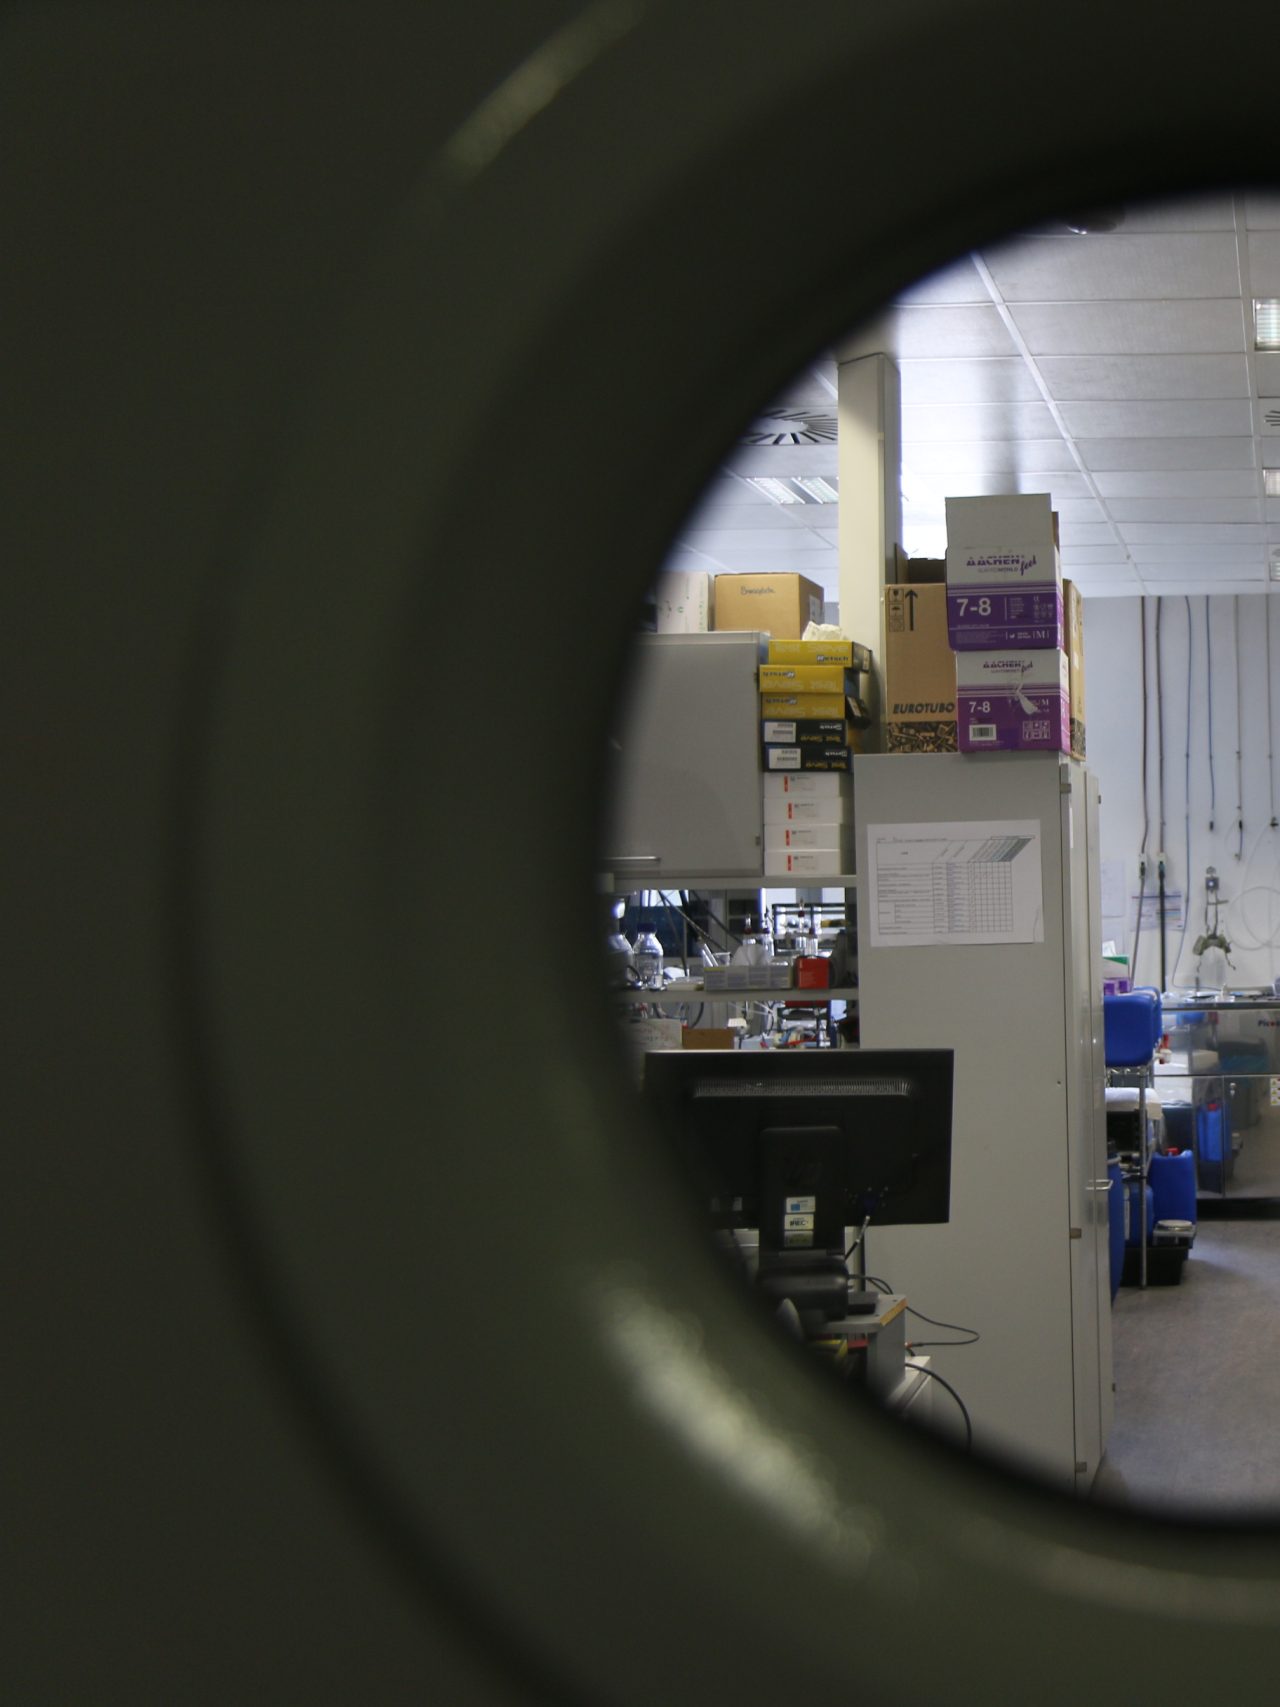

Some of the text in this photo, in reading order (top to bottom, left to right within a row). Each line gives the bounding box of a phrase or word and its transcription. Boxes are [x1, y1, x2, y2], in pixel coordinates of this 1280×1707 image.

[956, 597, 992, 617] 7-8
[893, 702, 955, 714] EUROTUBO
[968, 701, 991, 713] 7-8
